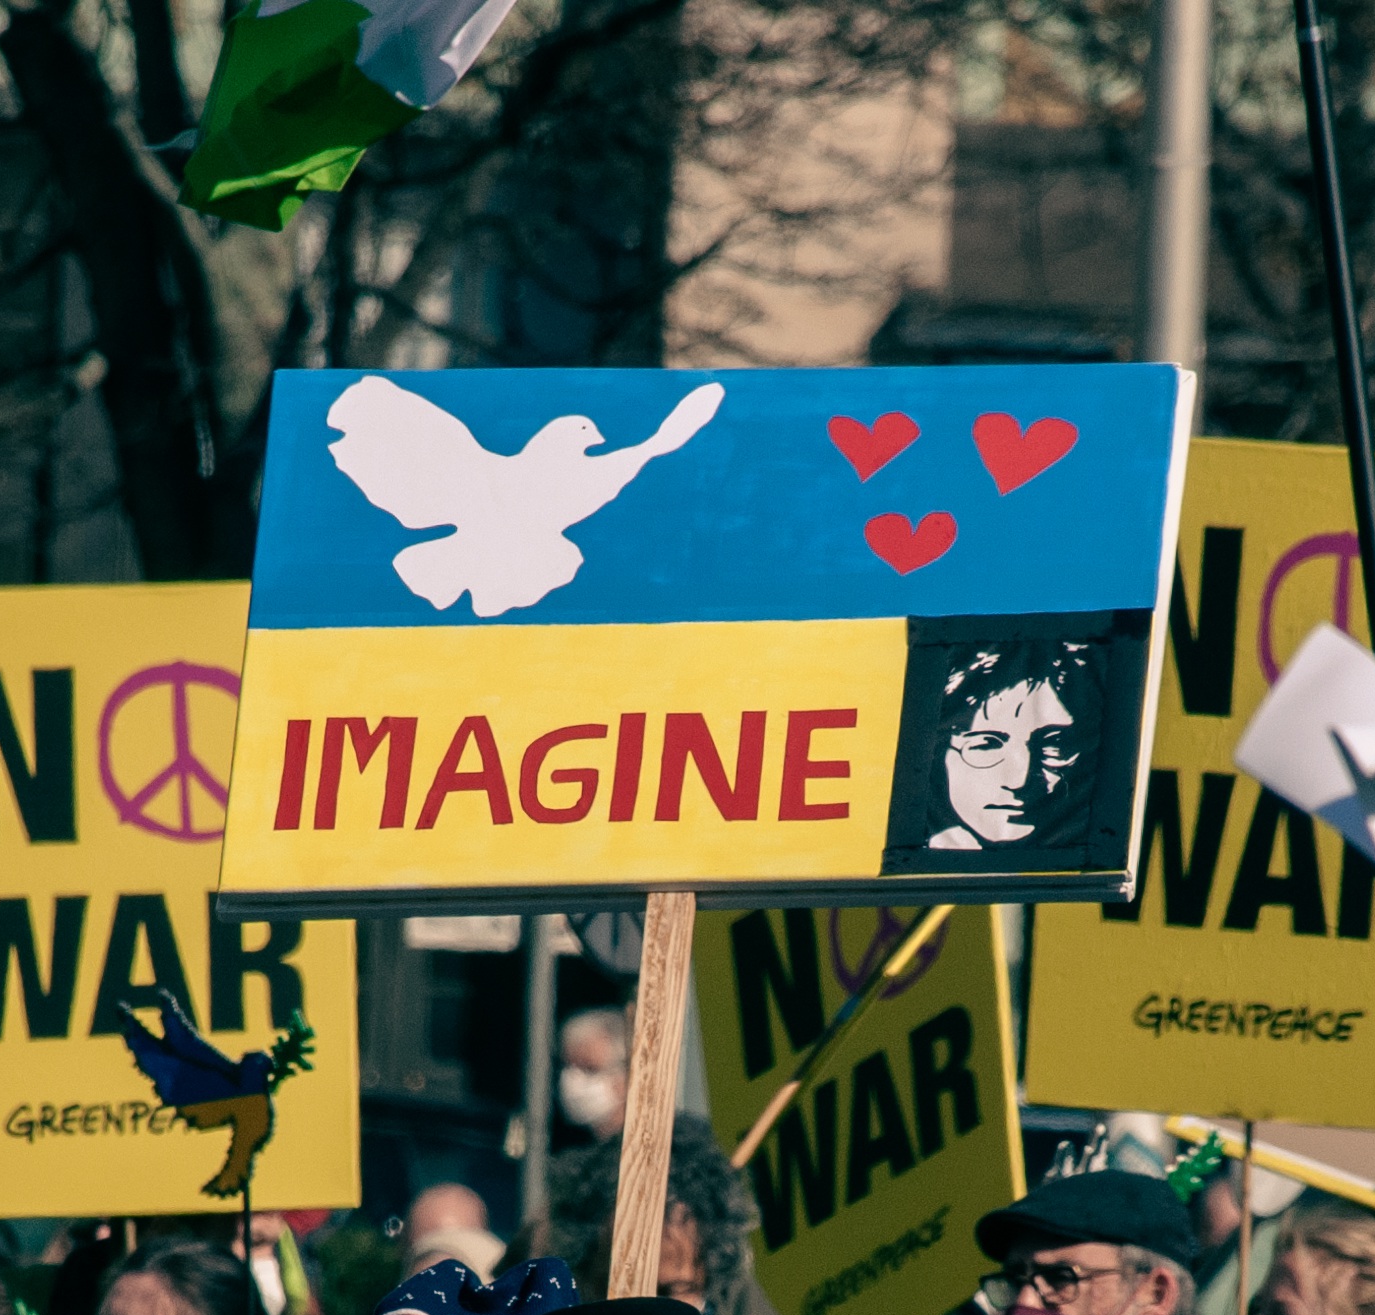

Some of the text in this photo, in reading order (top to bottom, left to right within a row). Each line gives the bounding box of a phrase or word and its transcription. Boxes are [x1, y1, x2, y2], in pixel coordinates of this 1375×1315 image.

[272, 708, 859, 832] IMAGINE
[1133, 991, 1366, 1044] GREENPEACE
[6, 1101, 190, 1144] GREENPE
[737, 1006, 982, 1252] WAR
